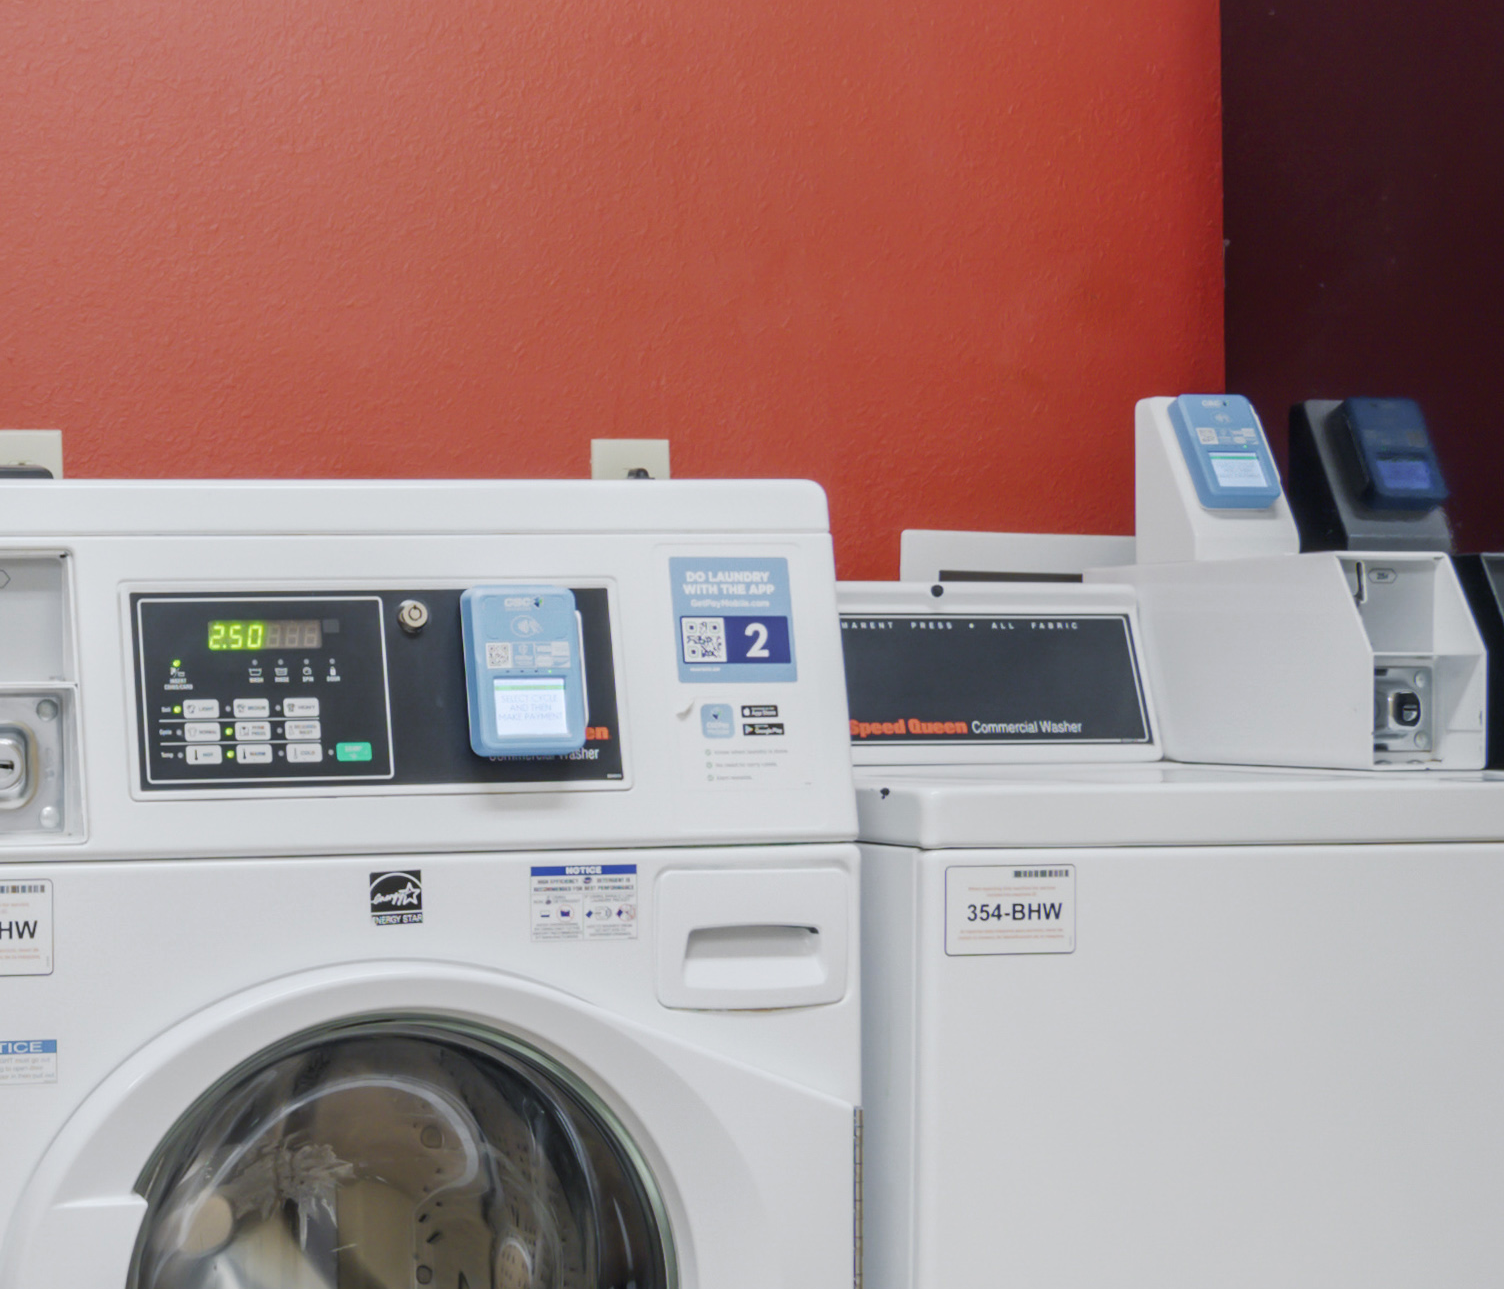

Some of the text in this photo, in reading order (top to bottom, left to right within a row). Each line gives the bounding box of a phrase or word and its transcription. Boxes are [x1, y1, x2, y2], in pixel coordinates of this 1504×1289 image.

[685, 571, 770, 583] DO LAUNDRY
[683, 584, 775, 595] WITH THE APP
[992, 622, 1015, 630] ALL
[1031, 622, 1079, 630] FABRIC
[209, 624, 264, 649] 2.50
[744, 622, 770, 658] 2
[501, 694, 558, 703] SELECT CYCLE
[499, 712, 562, 721] MAKE PAYMENT
[849, 719, 1082, 737] Speed Queen Commercial Washer
[565, 866, 602, 875] NOTICE
[967, 902, 1063, 922] 354-BHW
[373, 914, 423, 924] ENERGY STAR
